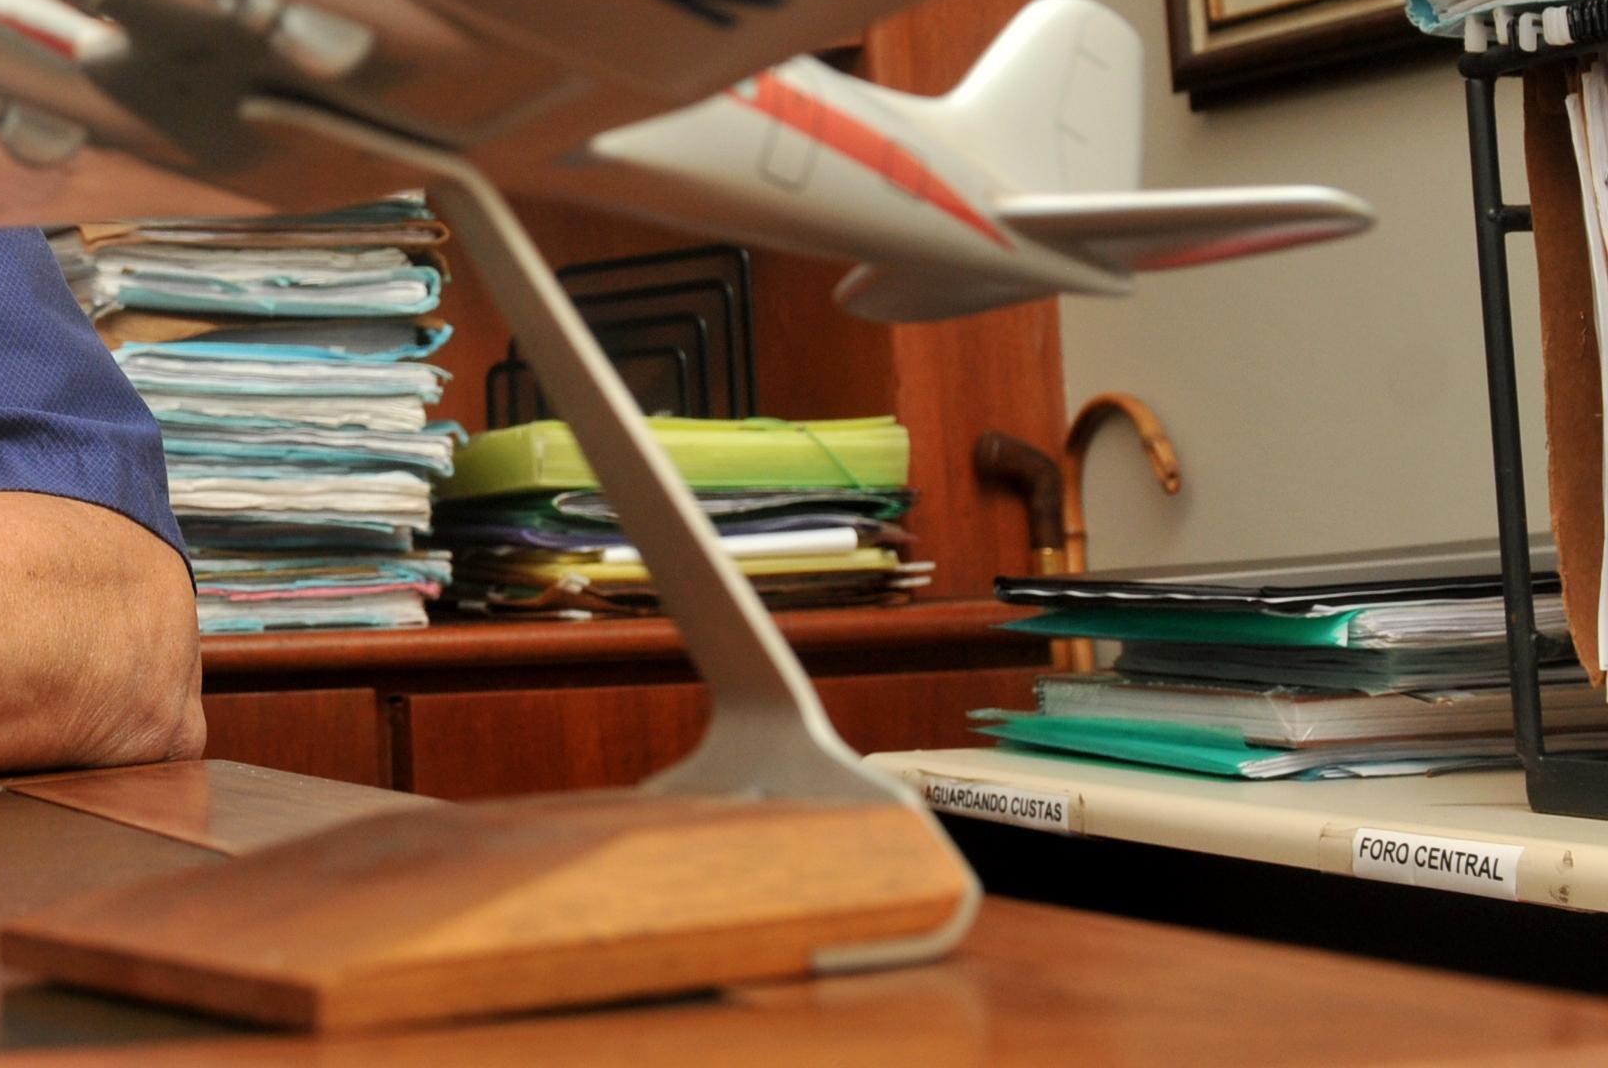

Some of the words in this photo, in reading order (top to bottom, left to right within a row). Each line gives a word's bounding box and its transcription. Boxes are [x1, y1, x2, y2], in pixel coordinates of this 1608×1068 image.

[925, 785, 1008, 814] AGUARDANDO
[1011, 796, 1063, 822] CUSTAS
[1358, 836, 1410, 865] FORO
[1414, 845, 1504, 882] CENTRAL
